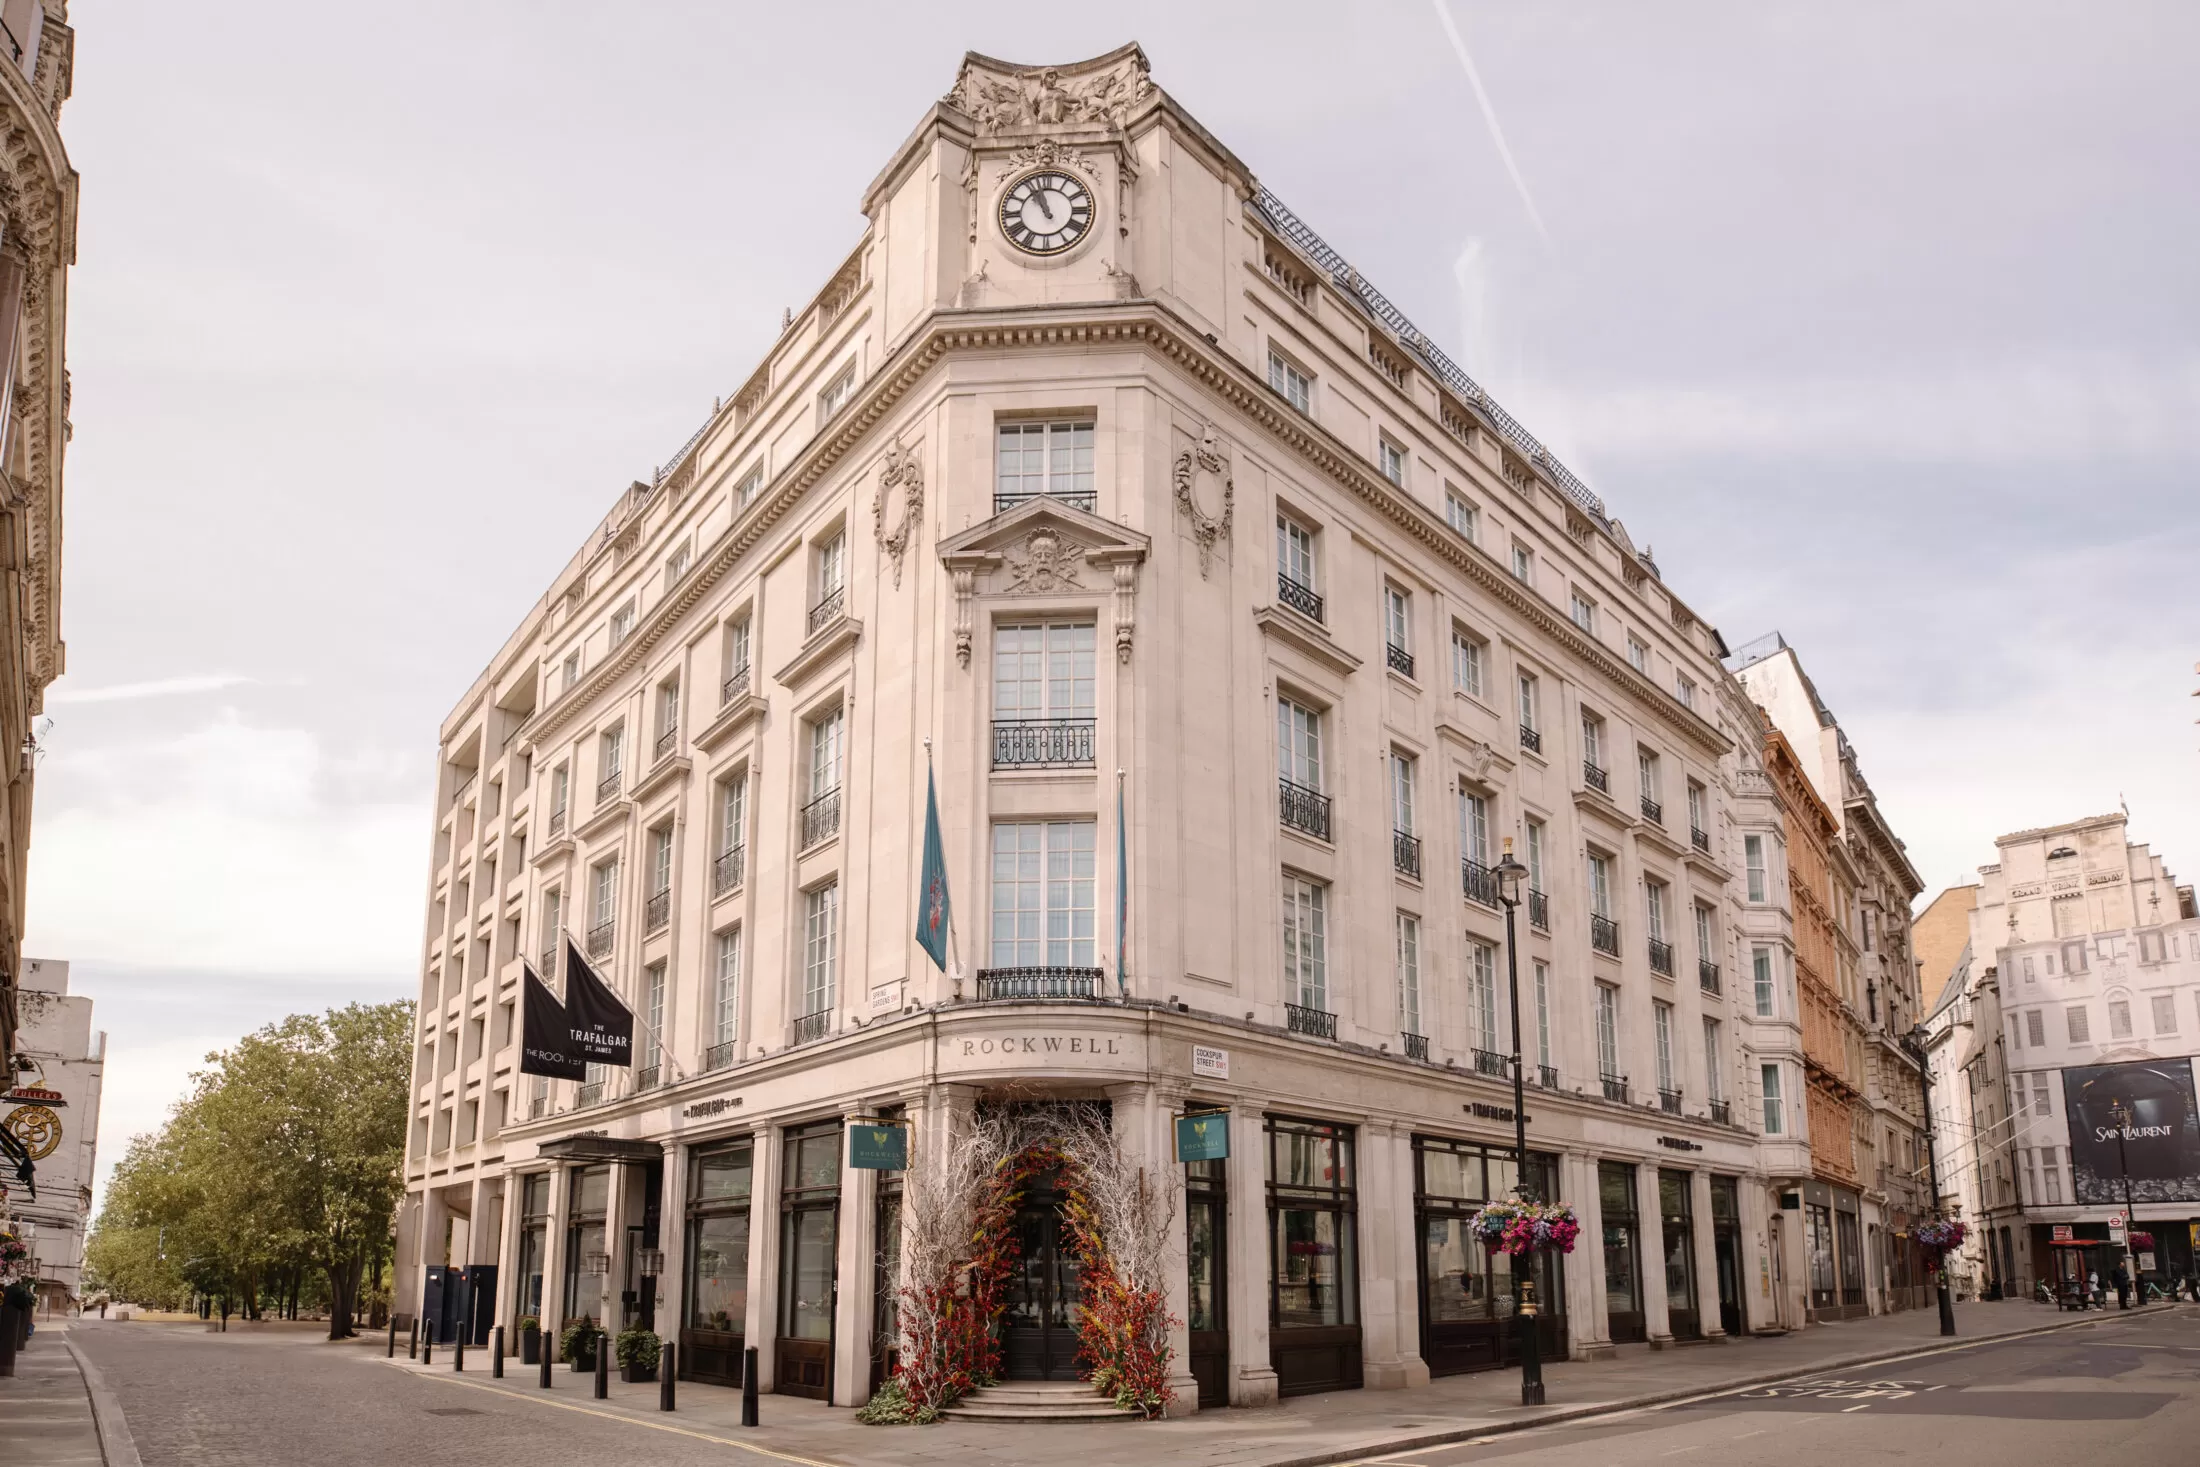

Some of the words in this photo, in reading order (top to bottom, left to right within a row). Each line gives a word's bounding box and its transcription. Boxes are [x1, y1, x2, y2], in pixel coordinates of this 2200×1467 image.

[594, 1024, 604, 1032] THE
[570, 1029, 628, 1047] TRAFALGAR
[526, 1048, 538, 1057] THE
[594, 1046, 612, 1054] JAMES
[963, 1037, 1119, 1056] ROCKWELL
[1196, 1048, 1223, 1061] COCKSPUR
[1196, 1057, 1214, 1068] STREET
[1472, 1102, 1514, 1122] TRAFALGAR
[2095, 1126, 2126, 1142] SAINT
[2126, 1125, 2172, 1140] LAURENT
[1740, 1388, 1917, 1399] STOP
